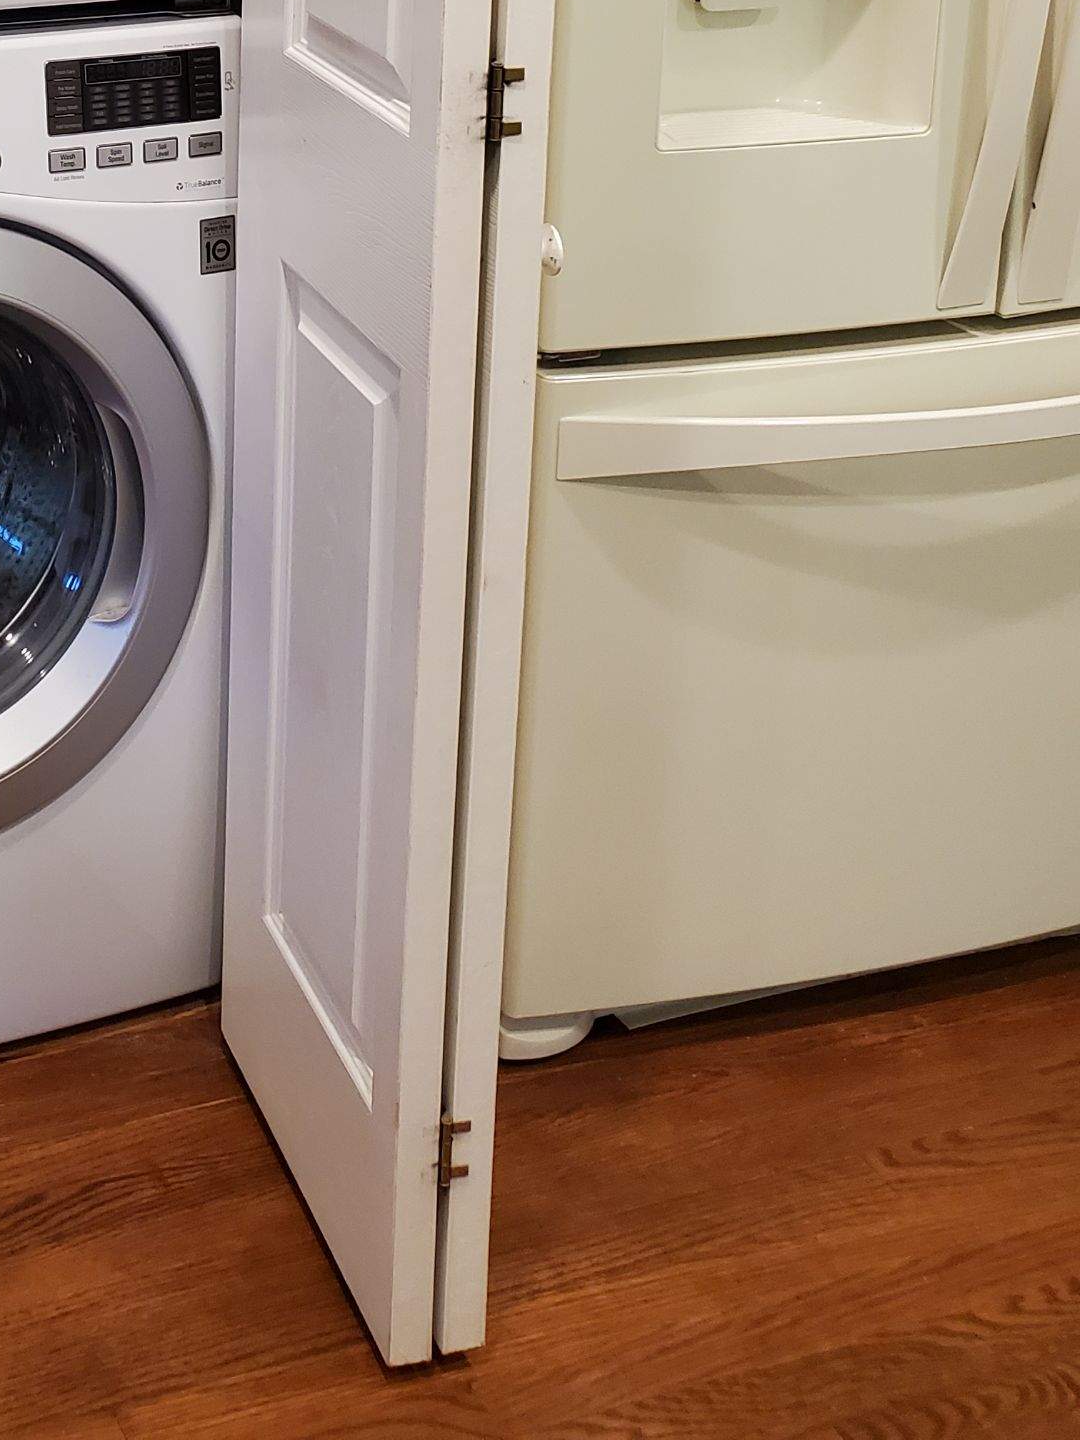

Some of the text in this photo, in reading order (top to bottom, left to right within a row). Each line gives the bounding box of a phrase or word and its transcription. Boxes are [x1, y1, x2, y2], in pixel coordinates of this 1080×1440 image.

[60, 153, 76, 161] Wash
[107, 155, 125, 163] Speed
[184, 178, 222, 189] TrueBalance
[205, 238, 231, 264] 10
